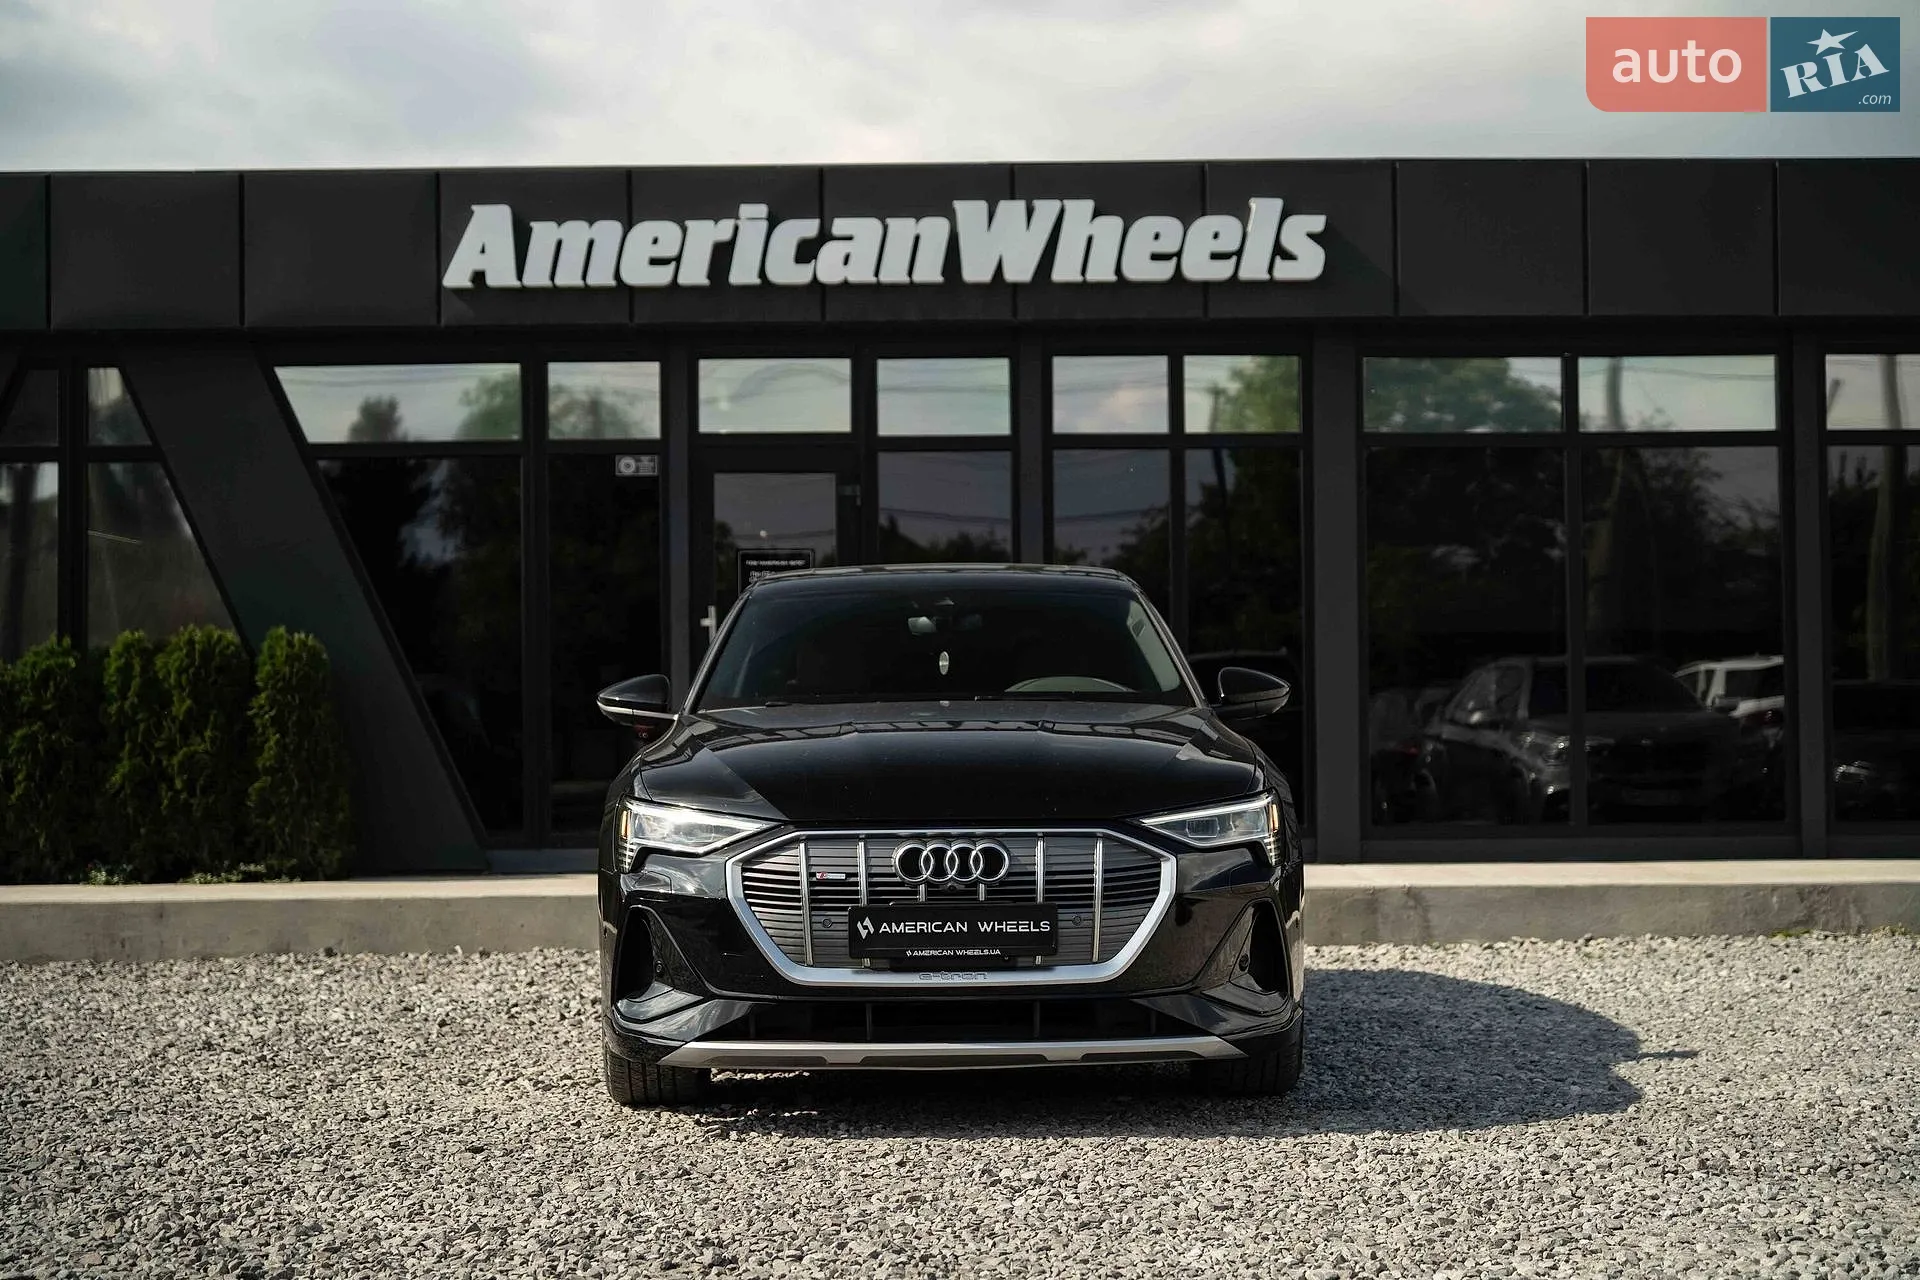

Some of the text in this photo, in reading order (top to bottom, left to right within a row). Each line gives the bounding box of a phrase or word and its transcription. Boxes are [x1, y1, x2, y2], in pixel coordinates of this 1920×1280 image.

[879, 920, 1051, 934] AMERICAN WHEELS
[913, 949, 954, 957] AMERICAN
[919, 971, 988, 980] e-tron
